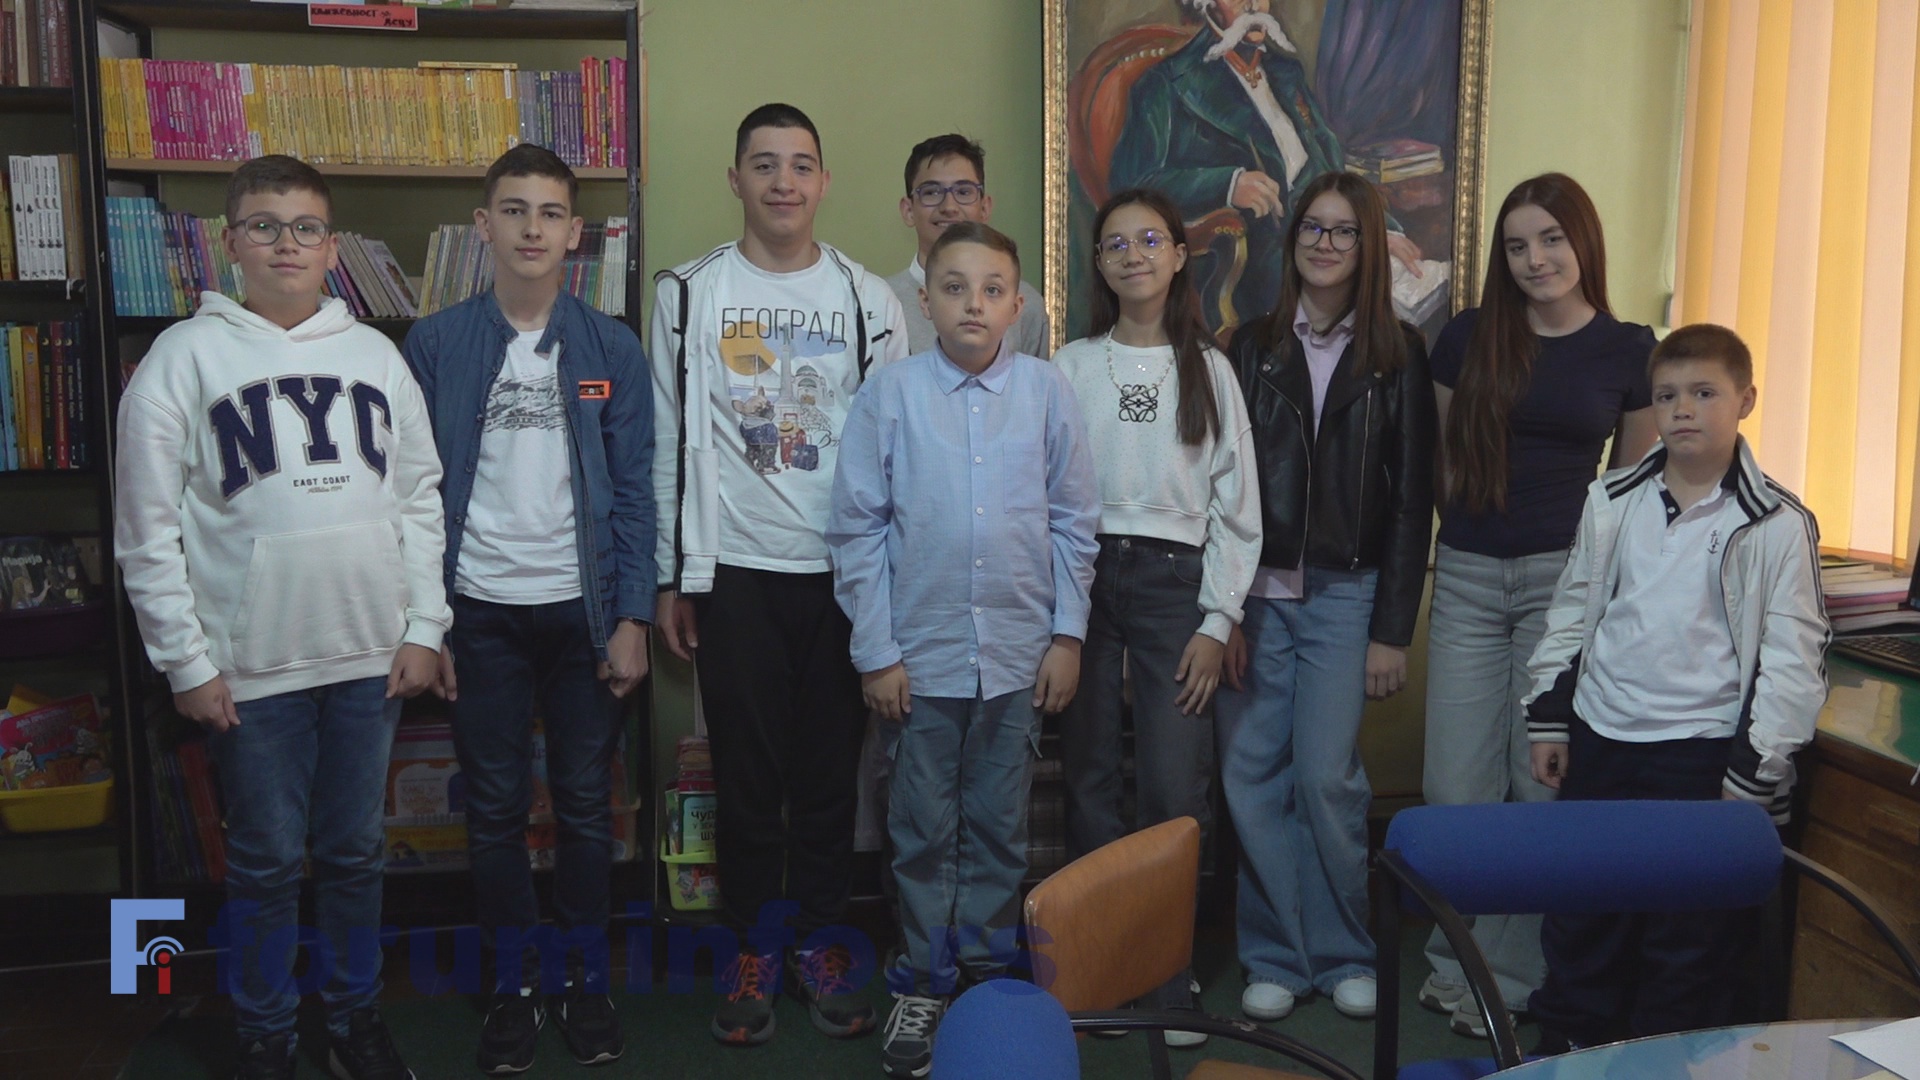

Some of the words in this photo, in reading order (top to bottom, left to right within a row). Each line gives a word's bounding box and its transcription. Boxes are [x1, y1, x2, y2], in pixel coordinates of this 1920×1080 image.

[629, 259, 637, 271] 2
[721, 307, 848, 349] БЕОГРАД
[207, 373, 394, 501] NYC
[292, 478, 318, 488] EAST
[322, 475, 351, 485] COAST
